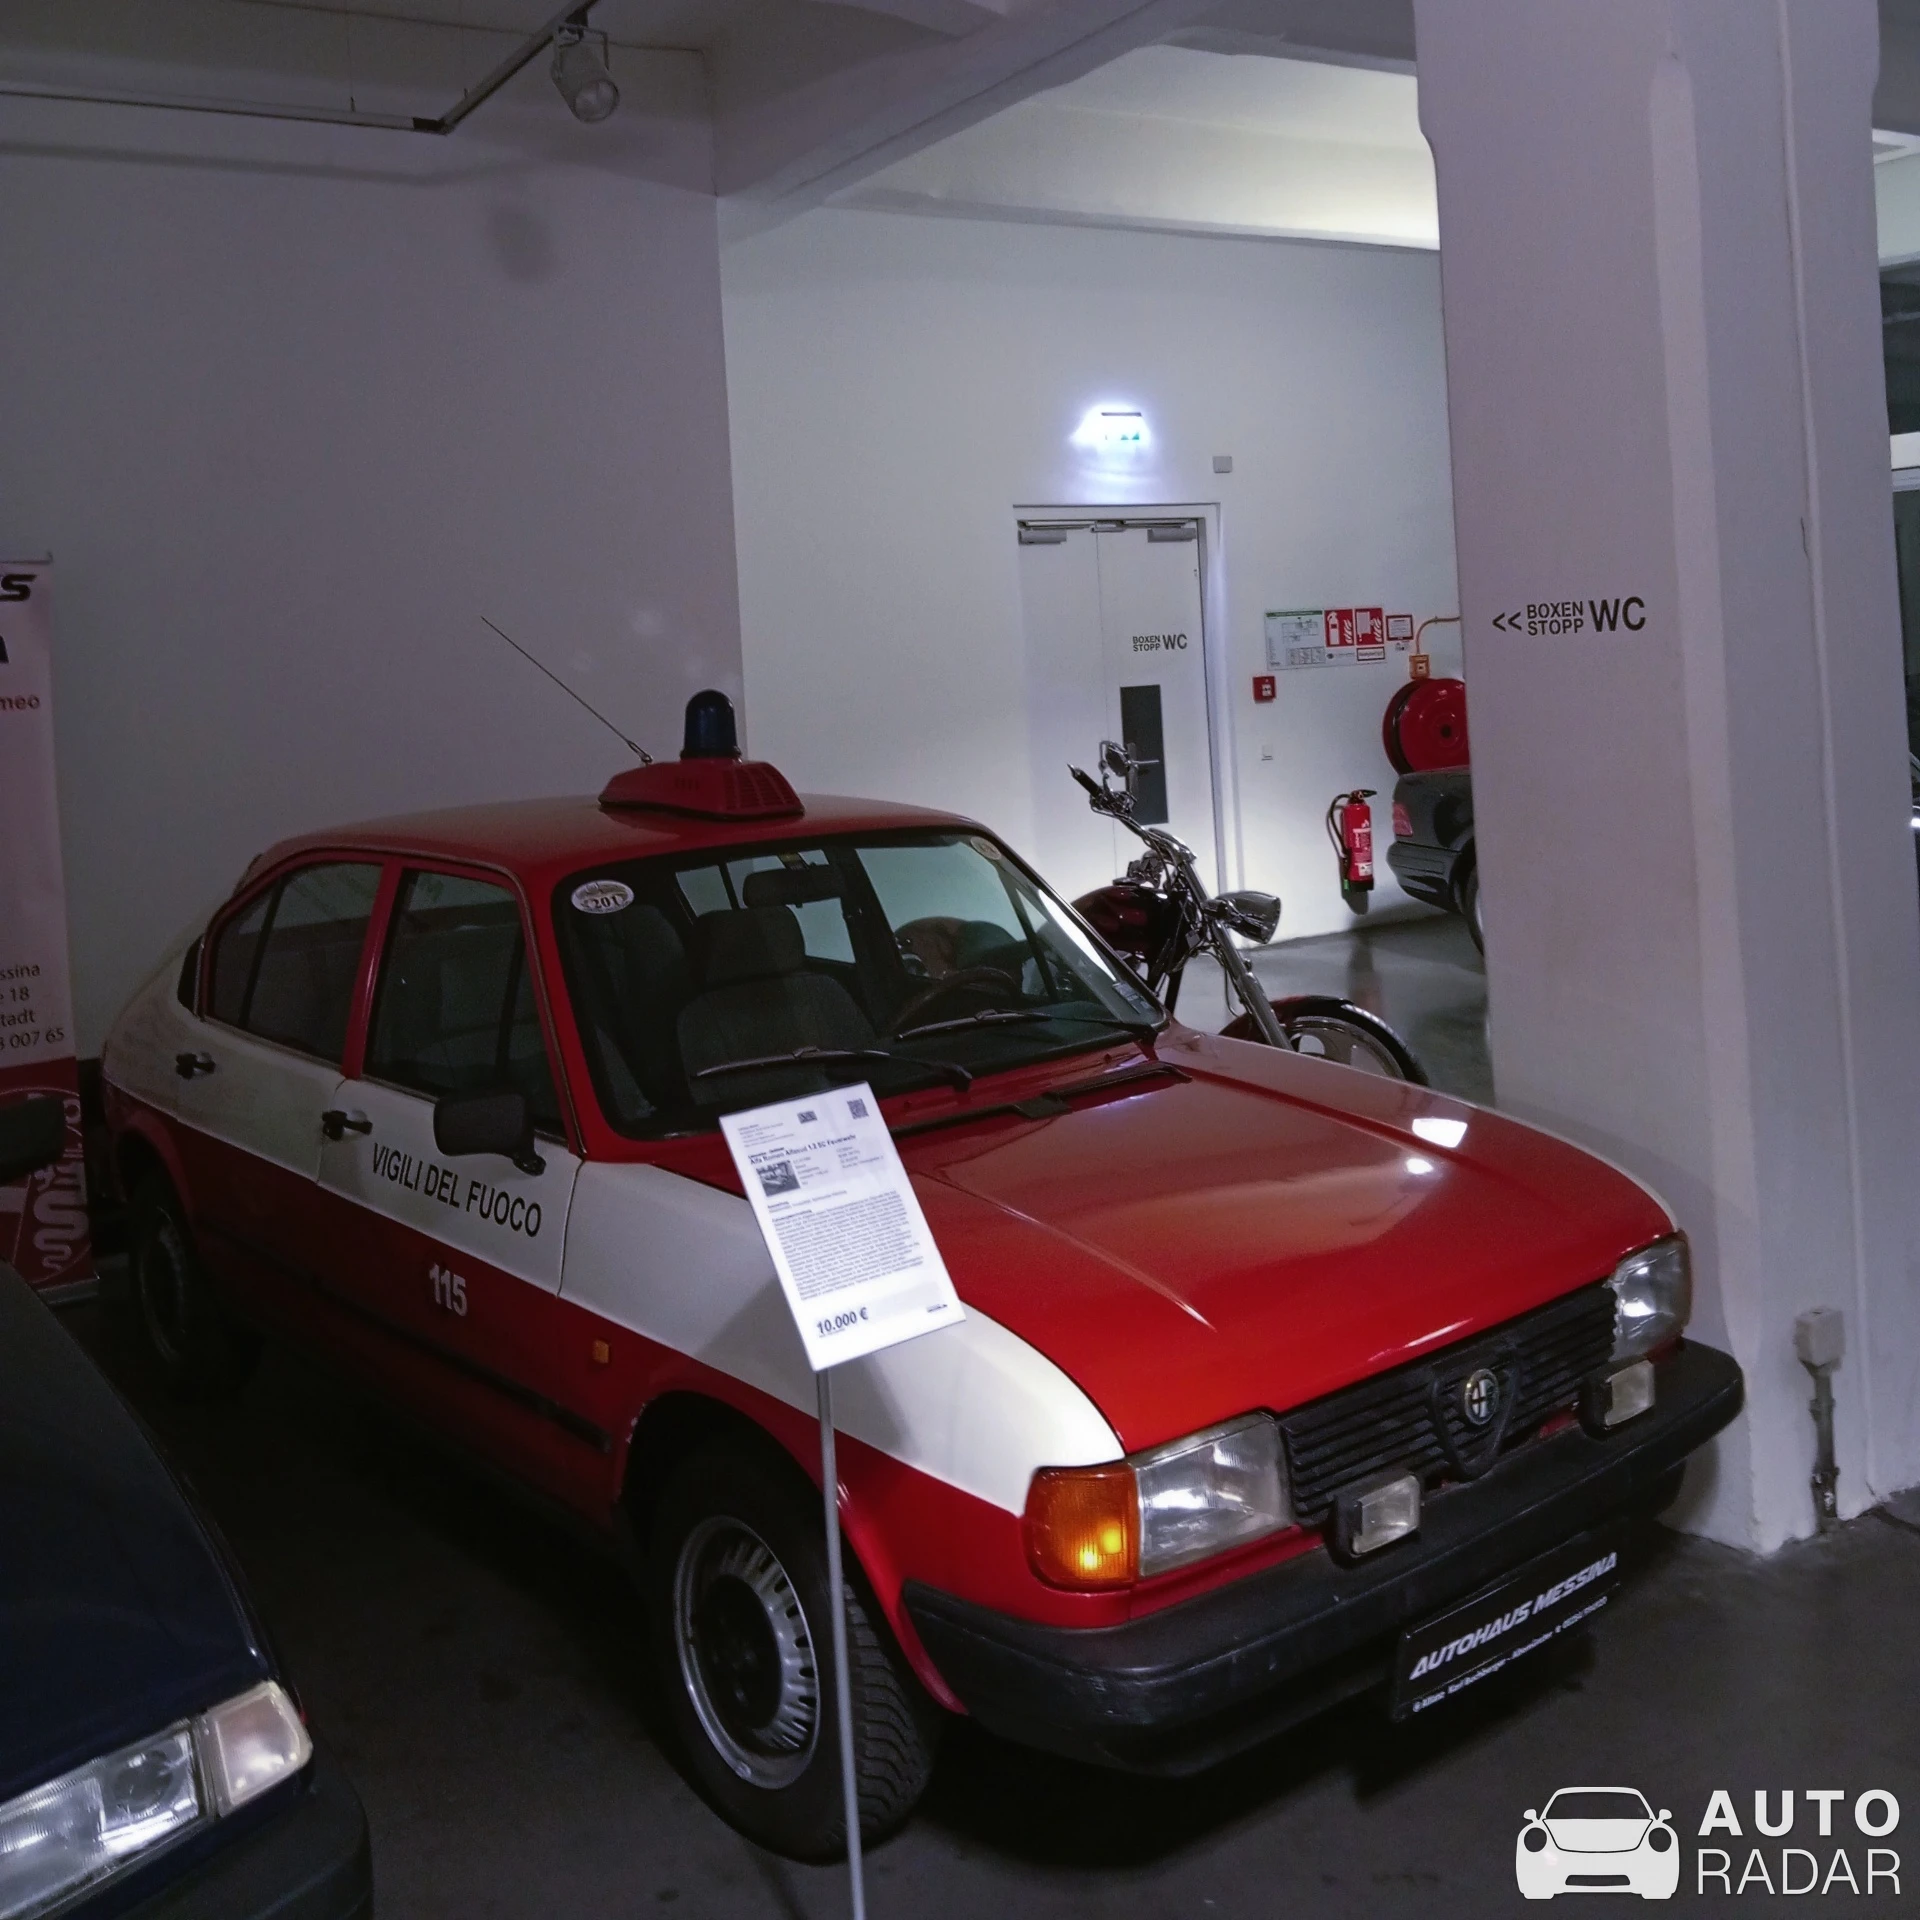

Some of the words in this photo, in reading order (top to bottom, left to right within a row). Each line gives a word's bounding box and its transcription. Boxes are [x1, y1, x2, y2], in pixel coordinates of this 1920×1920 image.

[1526, 601, 1584, 619] BOXEN
[1589, 596, 1646, 632] WC
[1527, 618, 1584, 636] STOPP
[1132, 635, 1161, 644] BOXEN
[1133, 643, 1161, 652] STOPP
[1162, 633, 1188, 651] WC
[10, 986, 30, 1002] 18
[9, 1030, 41, 1048] 007
[45, 1026, 65, 1043] 65
[372, 1142, 424, 1192] VIGILI
[423, 1163, 460, 1209] DEL
[465, 1180, 542, 1238] FUOCO
[429, 1262, 468, 1317] 115
[816, 1310, 857, 1335] 10.000
[859, 1306, 869, 1321] €
[1408, 1600, 1534, 1681] AUTOHAUS
[1531, 1551, 1618, 1615] MESSINA
